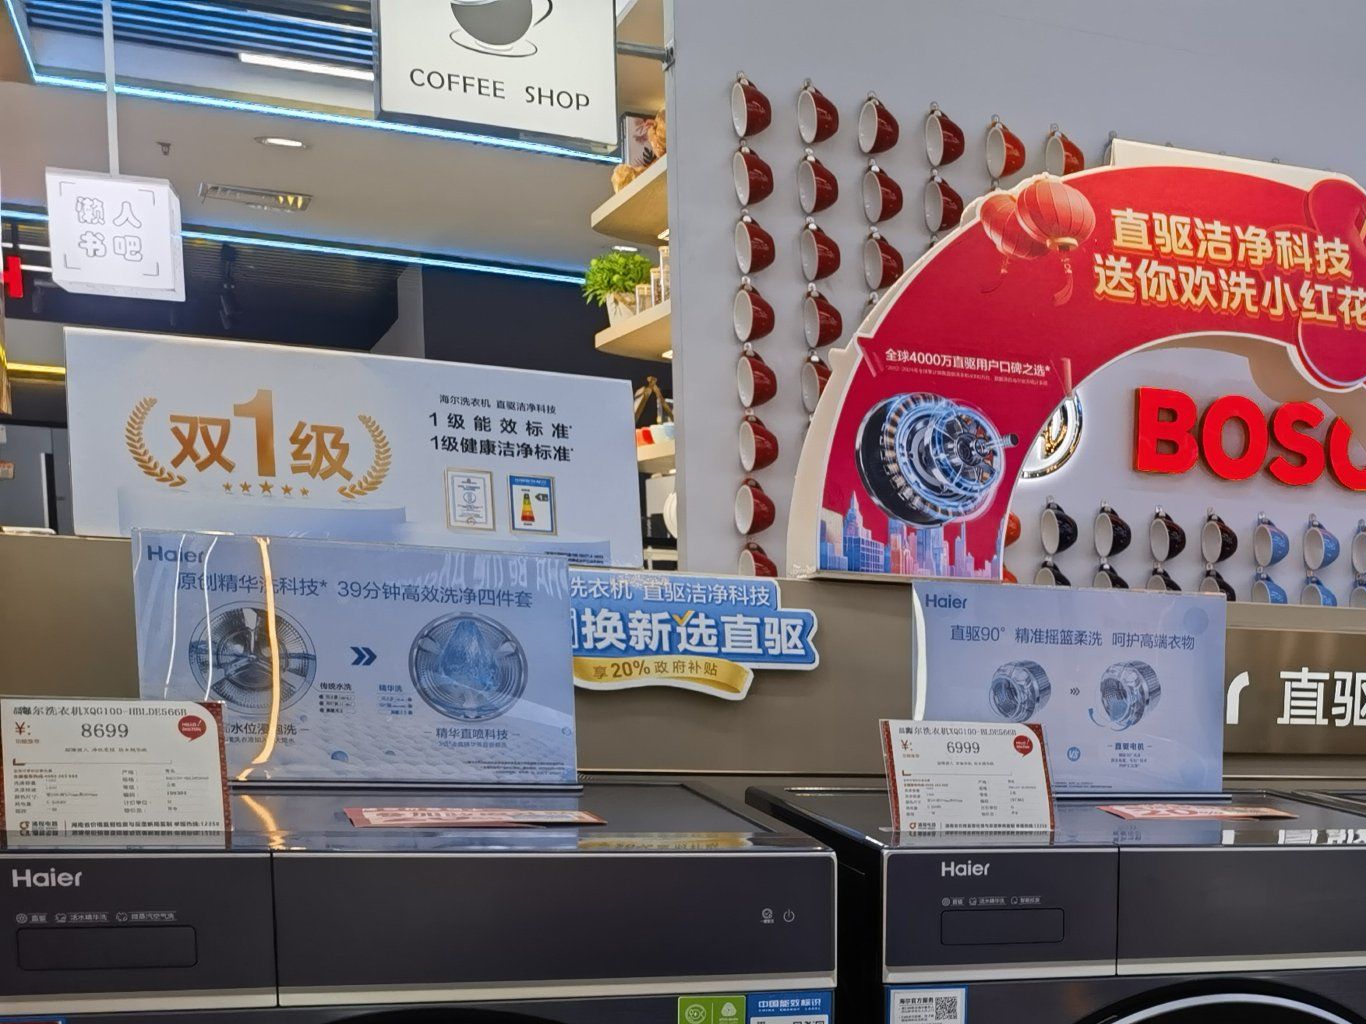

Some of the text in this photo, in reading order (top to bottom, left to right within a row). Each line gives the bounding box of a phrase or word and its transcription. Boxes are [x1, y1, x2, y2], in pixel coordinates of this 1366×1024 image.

[410, 67, 591, 112] COFFEE SHOP
[75, 196, 142, 229] 懒人
[78, 231, 143, 262] 书吧
[1110, 207, 1353, 278] 直驱洁净科技
[439, 394, 557, 415] 海尔洗衣机 直驱洁净科技
[168, 388, 354, 482] 双1级
[147, 545, 205, 563] Haier
[337, 580, 533, 609] 39分钟高效洗净四件套
[643, 579, 771, 607] 直驱洁净科技
[924, 593, 968, 610] Haier
[570, 607, 807, 656] 换新选直驱
[950, 624, 1196, 651] 直驱90° 精准摇篮柔洗 呵护高端衣物
[81, 723, 130, 739] 8699
[435, 728, 509, 741] 精华直喷科技
[946, 741, 981, 755] 6999
[1114, 742, 1145, 752] 直驱电机
[12, 868, 83, 888] Haier
[941, 860, 990, 877] Haier
[758, 998, 822, 1009] 中国能效标识
